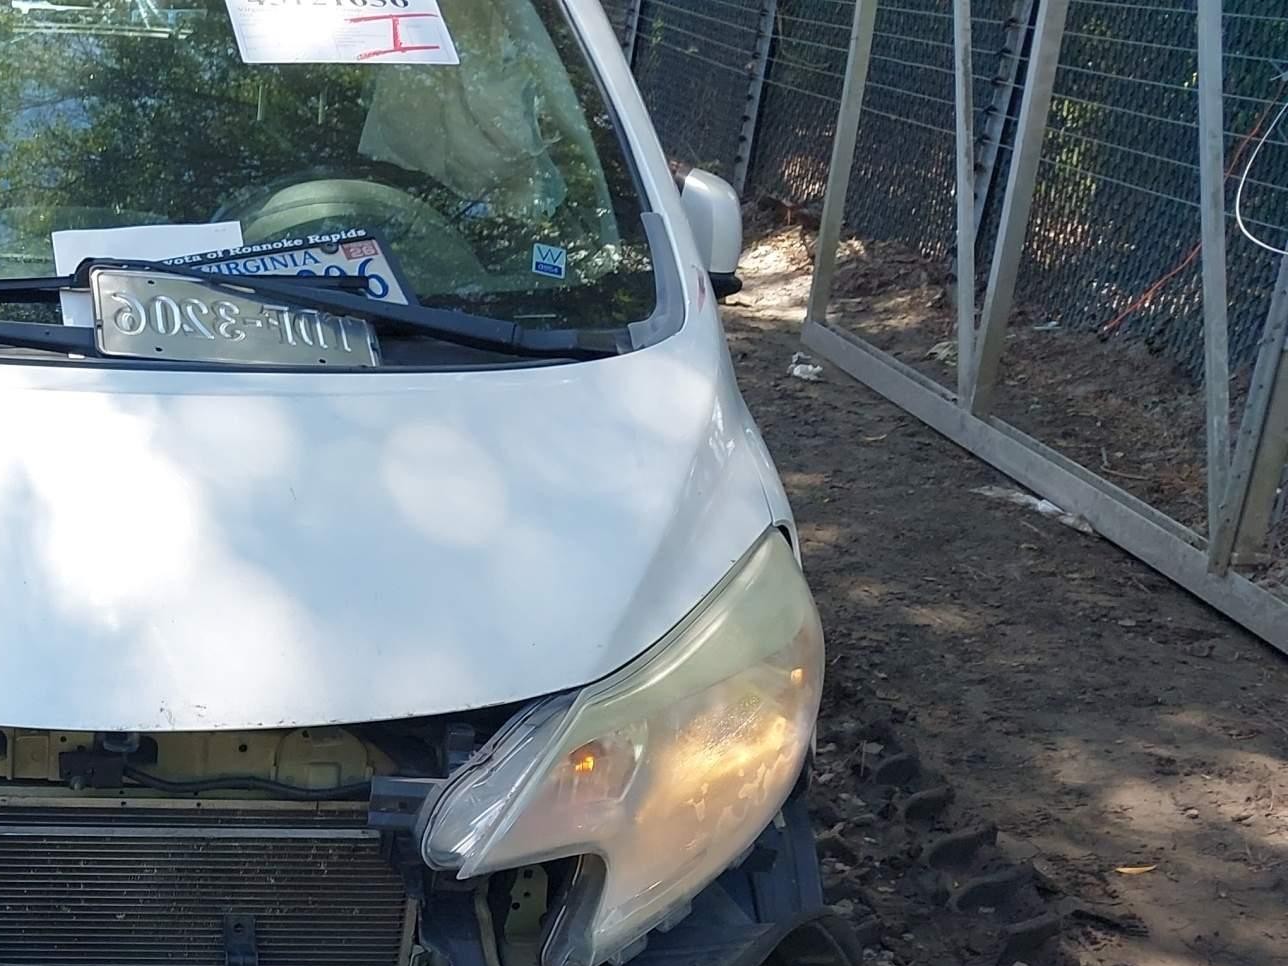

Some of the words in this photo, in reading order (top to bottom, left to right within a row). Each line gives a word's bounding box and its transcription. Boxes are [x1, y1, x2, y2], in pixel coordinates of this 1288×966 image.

[206, 248, 226, 259] of
[228, 238, 303, 256] Roanoke
[307, 228, 367, 244] Rapids
[536, 245, 563, 264] W
